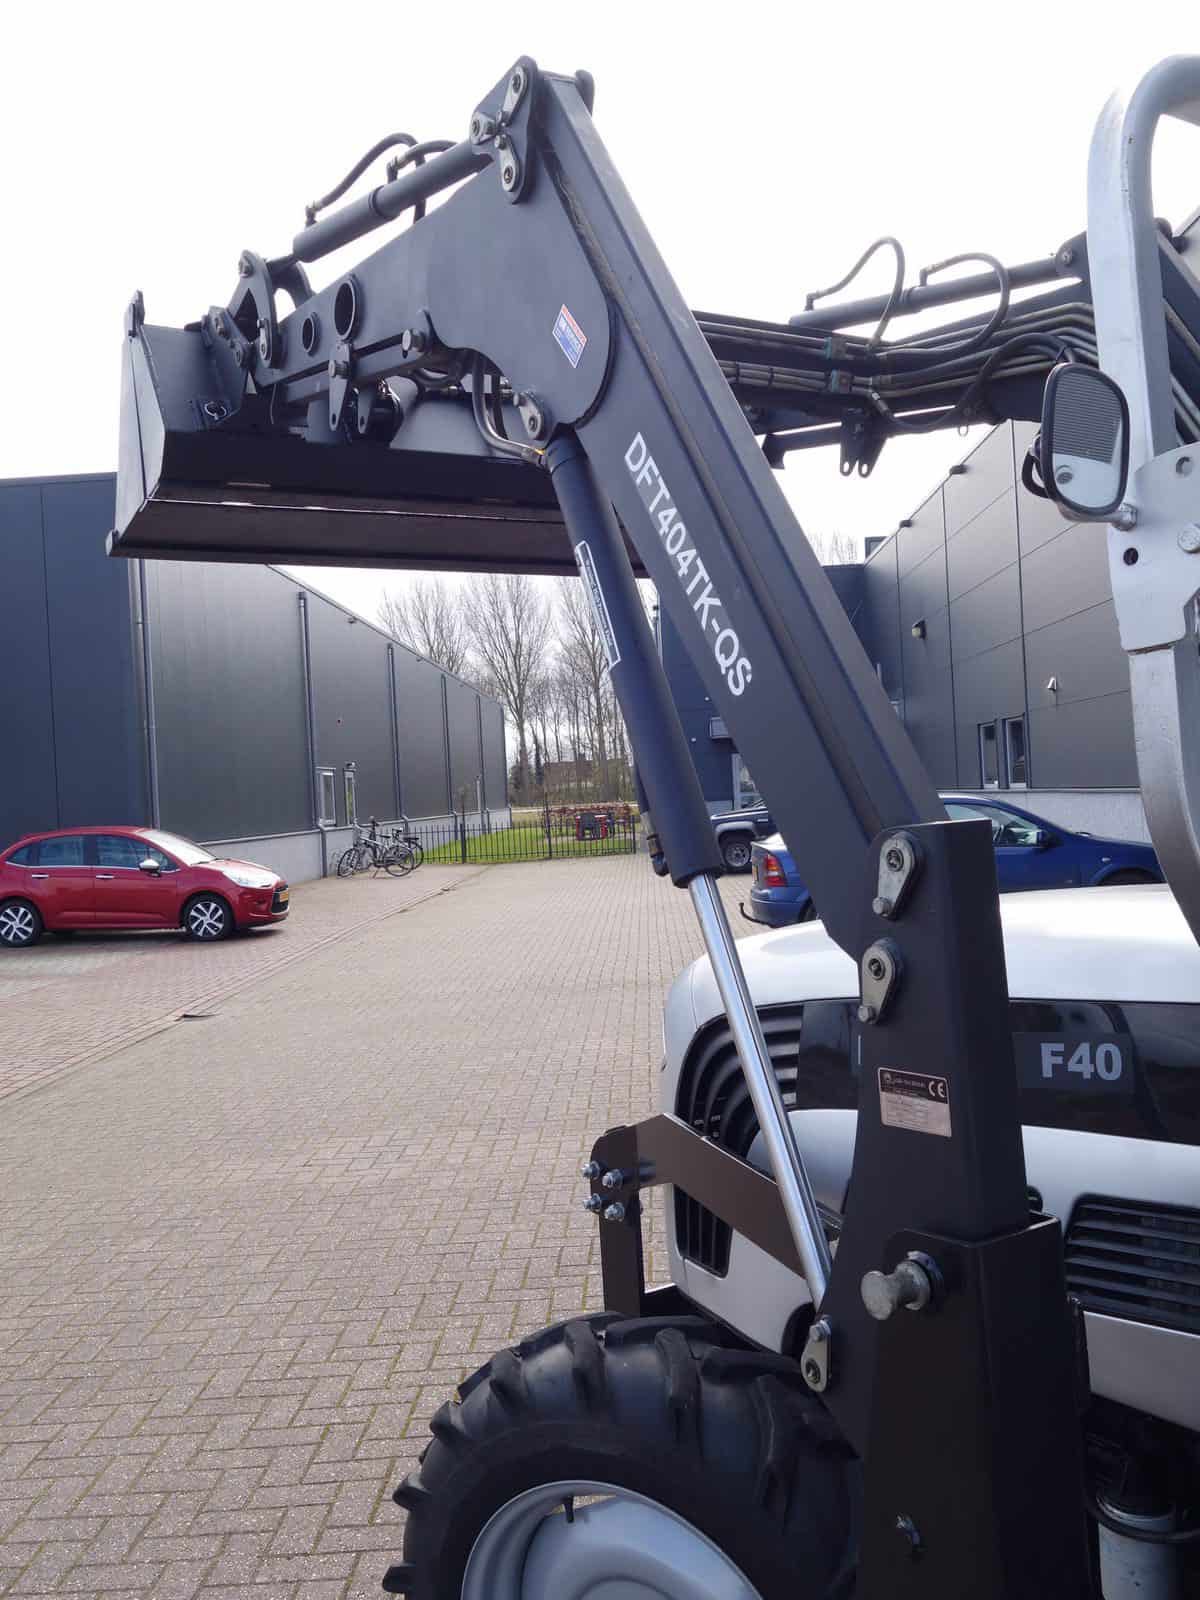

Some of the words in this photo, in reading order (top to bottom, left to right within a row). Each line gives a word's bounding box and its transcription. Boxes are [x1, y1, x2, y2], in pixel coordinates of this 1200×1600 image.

[624, 431, 753, 697] DFT404TK-QS
[1040, 1041, 1122, 1081] F40
[928, 1080, 946, 1098] CE
